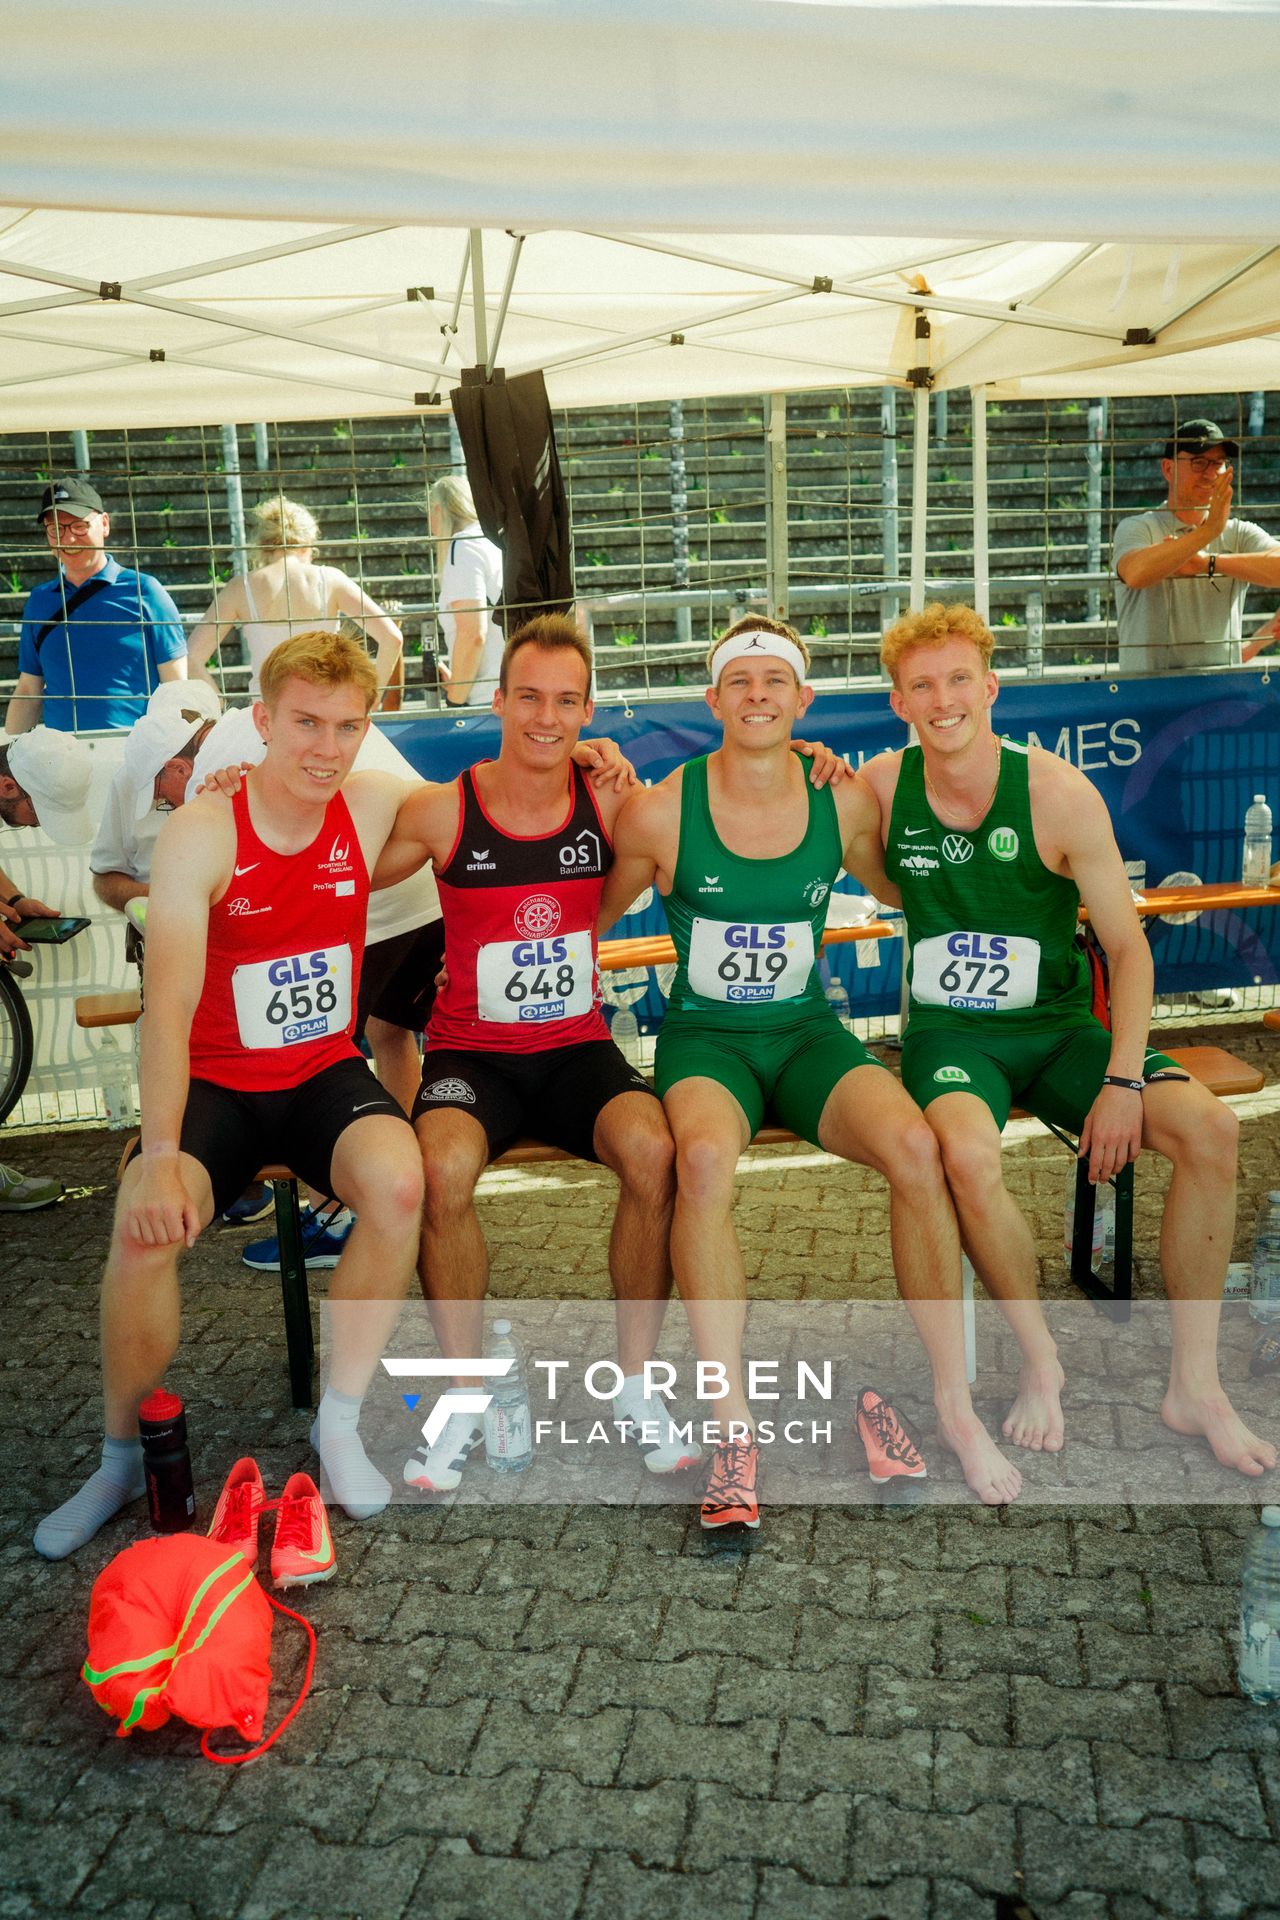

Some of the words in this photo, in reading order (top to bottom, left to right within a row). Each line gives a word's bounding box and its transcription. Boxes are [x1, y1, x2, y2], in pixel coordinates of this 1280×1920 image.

[1001, 718, 1142, 772] MES
[559, 844, 590, 866] OS
[466, 861, 497, 871] erima
[698, 885, 724, 893] erima
[717, 951, 788, 983] 619
[504, 964, 575, 1003] 648
[939, 960, 1010, 997] 672
[747, 988, 773, 996] PLAN
[265, 979, 337, 1025] 658
[539, 1003, 564, 1015] PLAN
[968, 1000, 995, 1009] PLAN
[301, 1019, 326, 1033] PLAN
